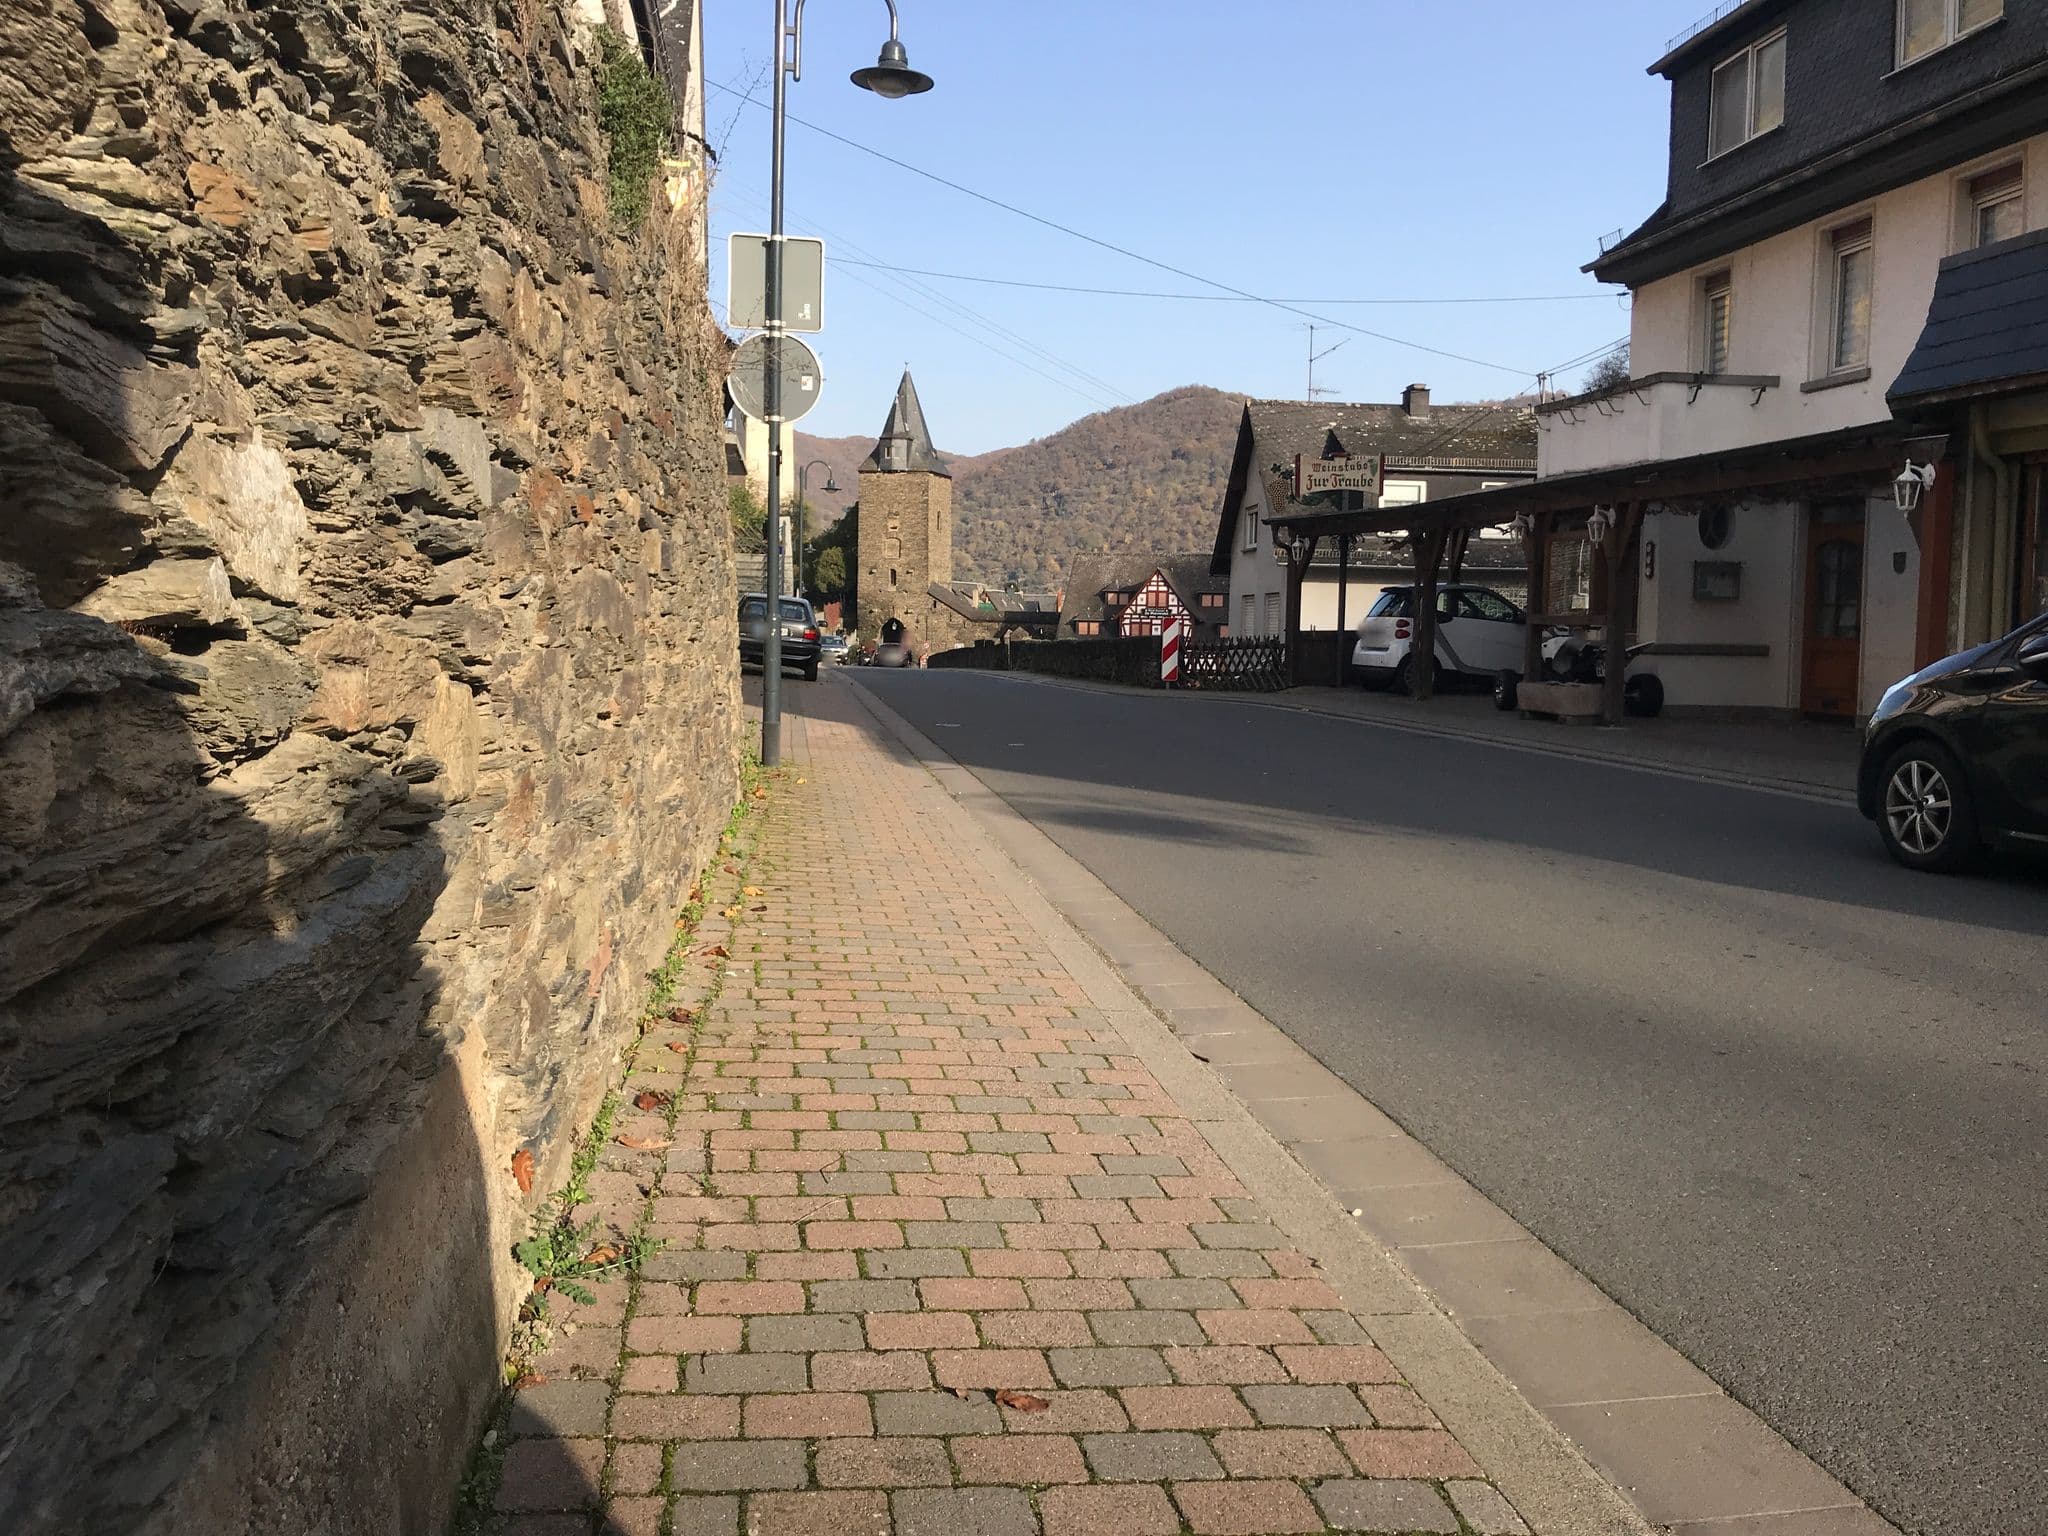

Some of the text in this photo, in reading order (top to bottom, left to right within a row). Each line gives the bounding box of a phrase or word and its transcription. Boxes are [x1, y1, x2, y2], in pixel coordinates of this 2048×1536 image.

[1312, 461, 1368, 473] Weinstube
[1306, 473, 1374, 491] Zur Traube
